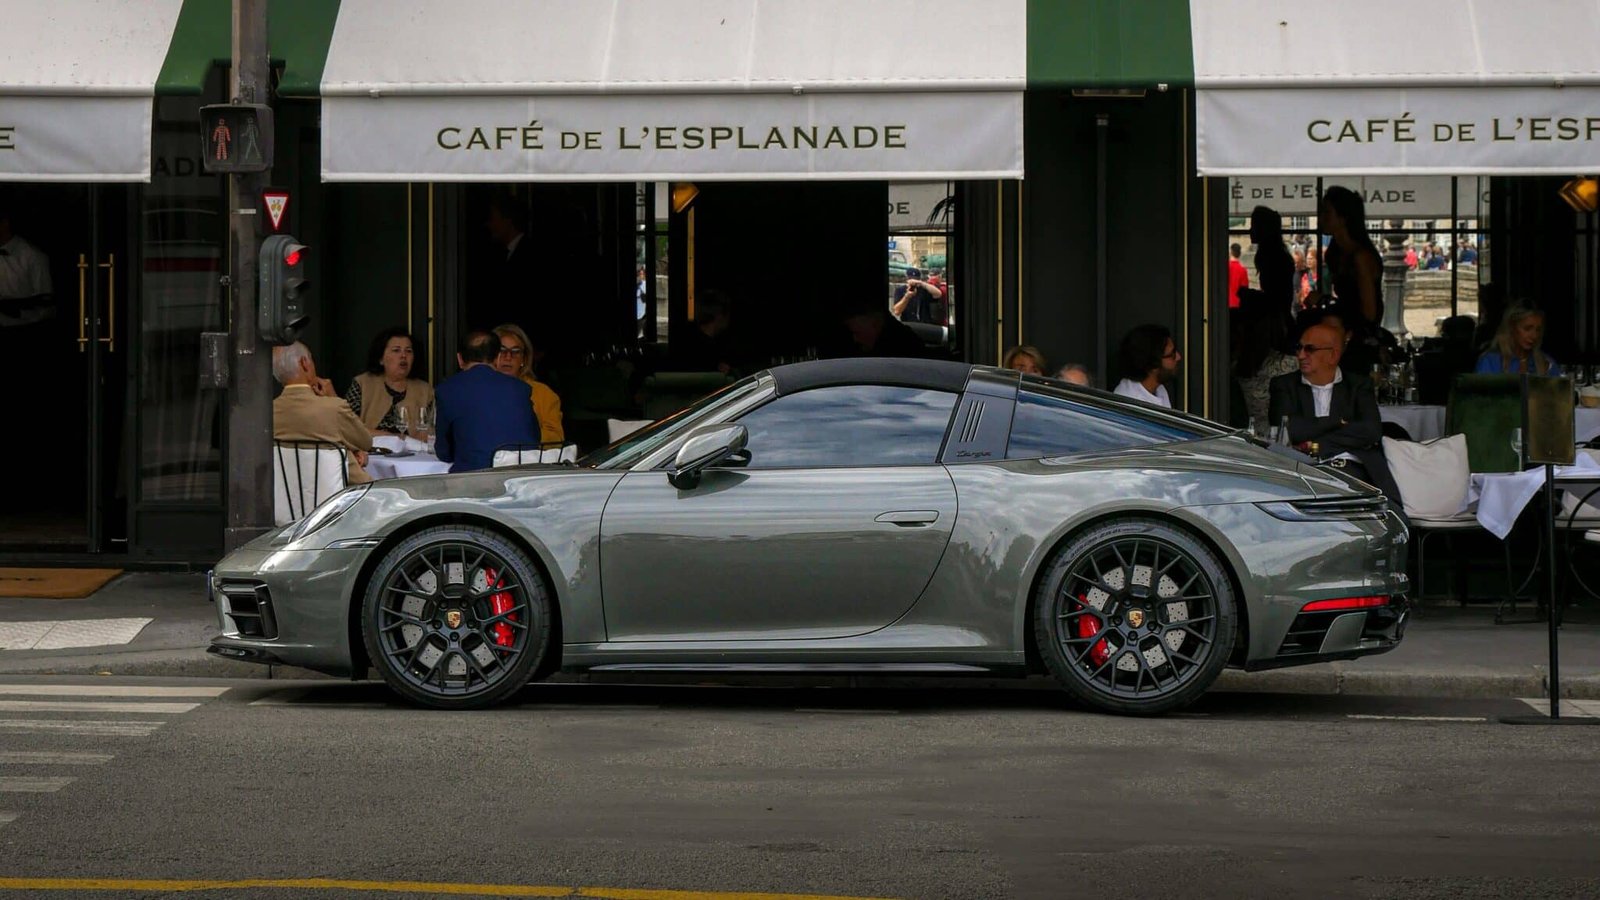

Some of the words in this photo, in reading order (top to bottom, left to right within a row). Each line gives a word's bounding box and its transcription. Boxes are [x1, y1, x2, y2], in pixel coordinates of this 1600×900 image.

[437, 120, 544, 150] CAFÉ
[560, 131, 602, 150] DE
[618, 125, 907, 150] L'ESPLANADE
[1307, 112, 1417, 143] CAFÉ
[1433, 123, 1475, 142] DE
[1251, 188, 1274, 199] DE
